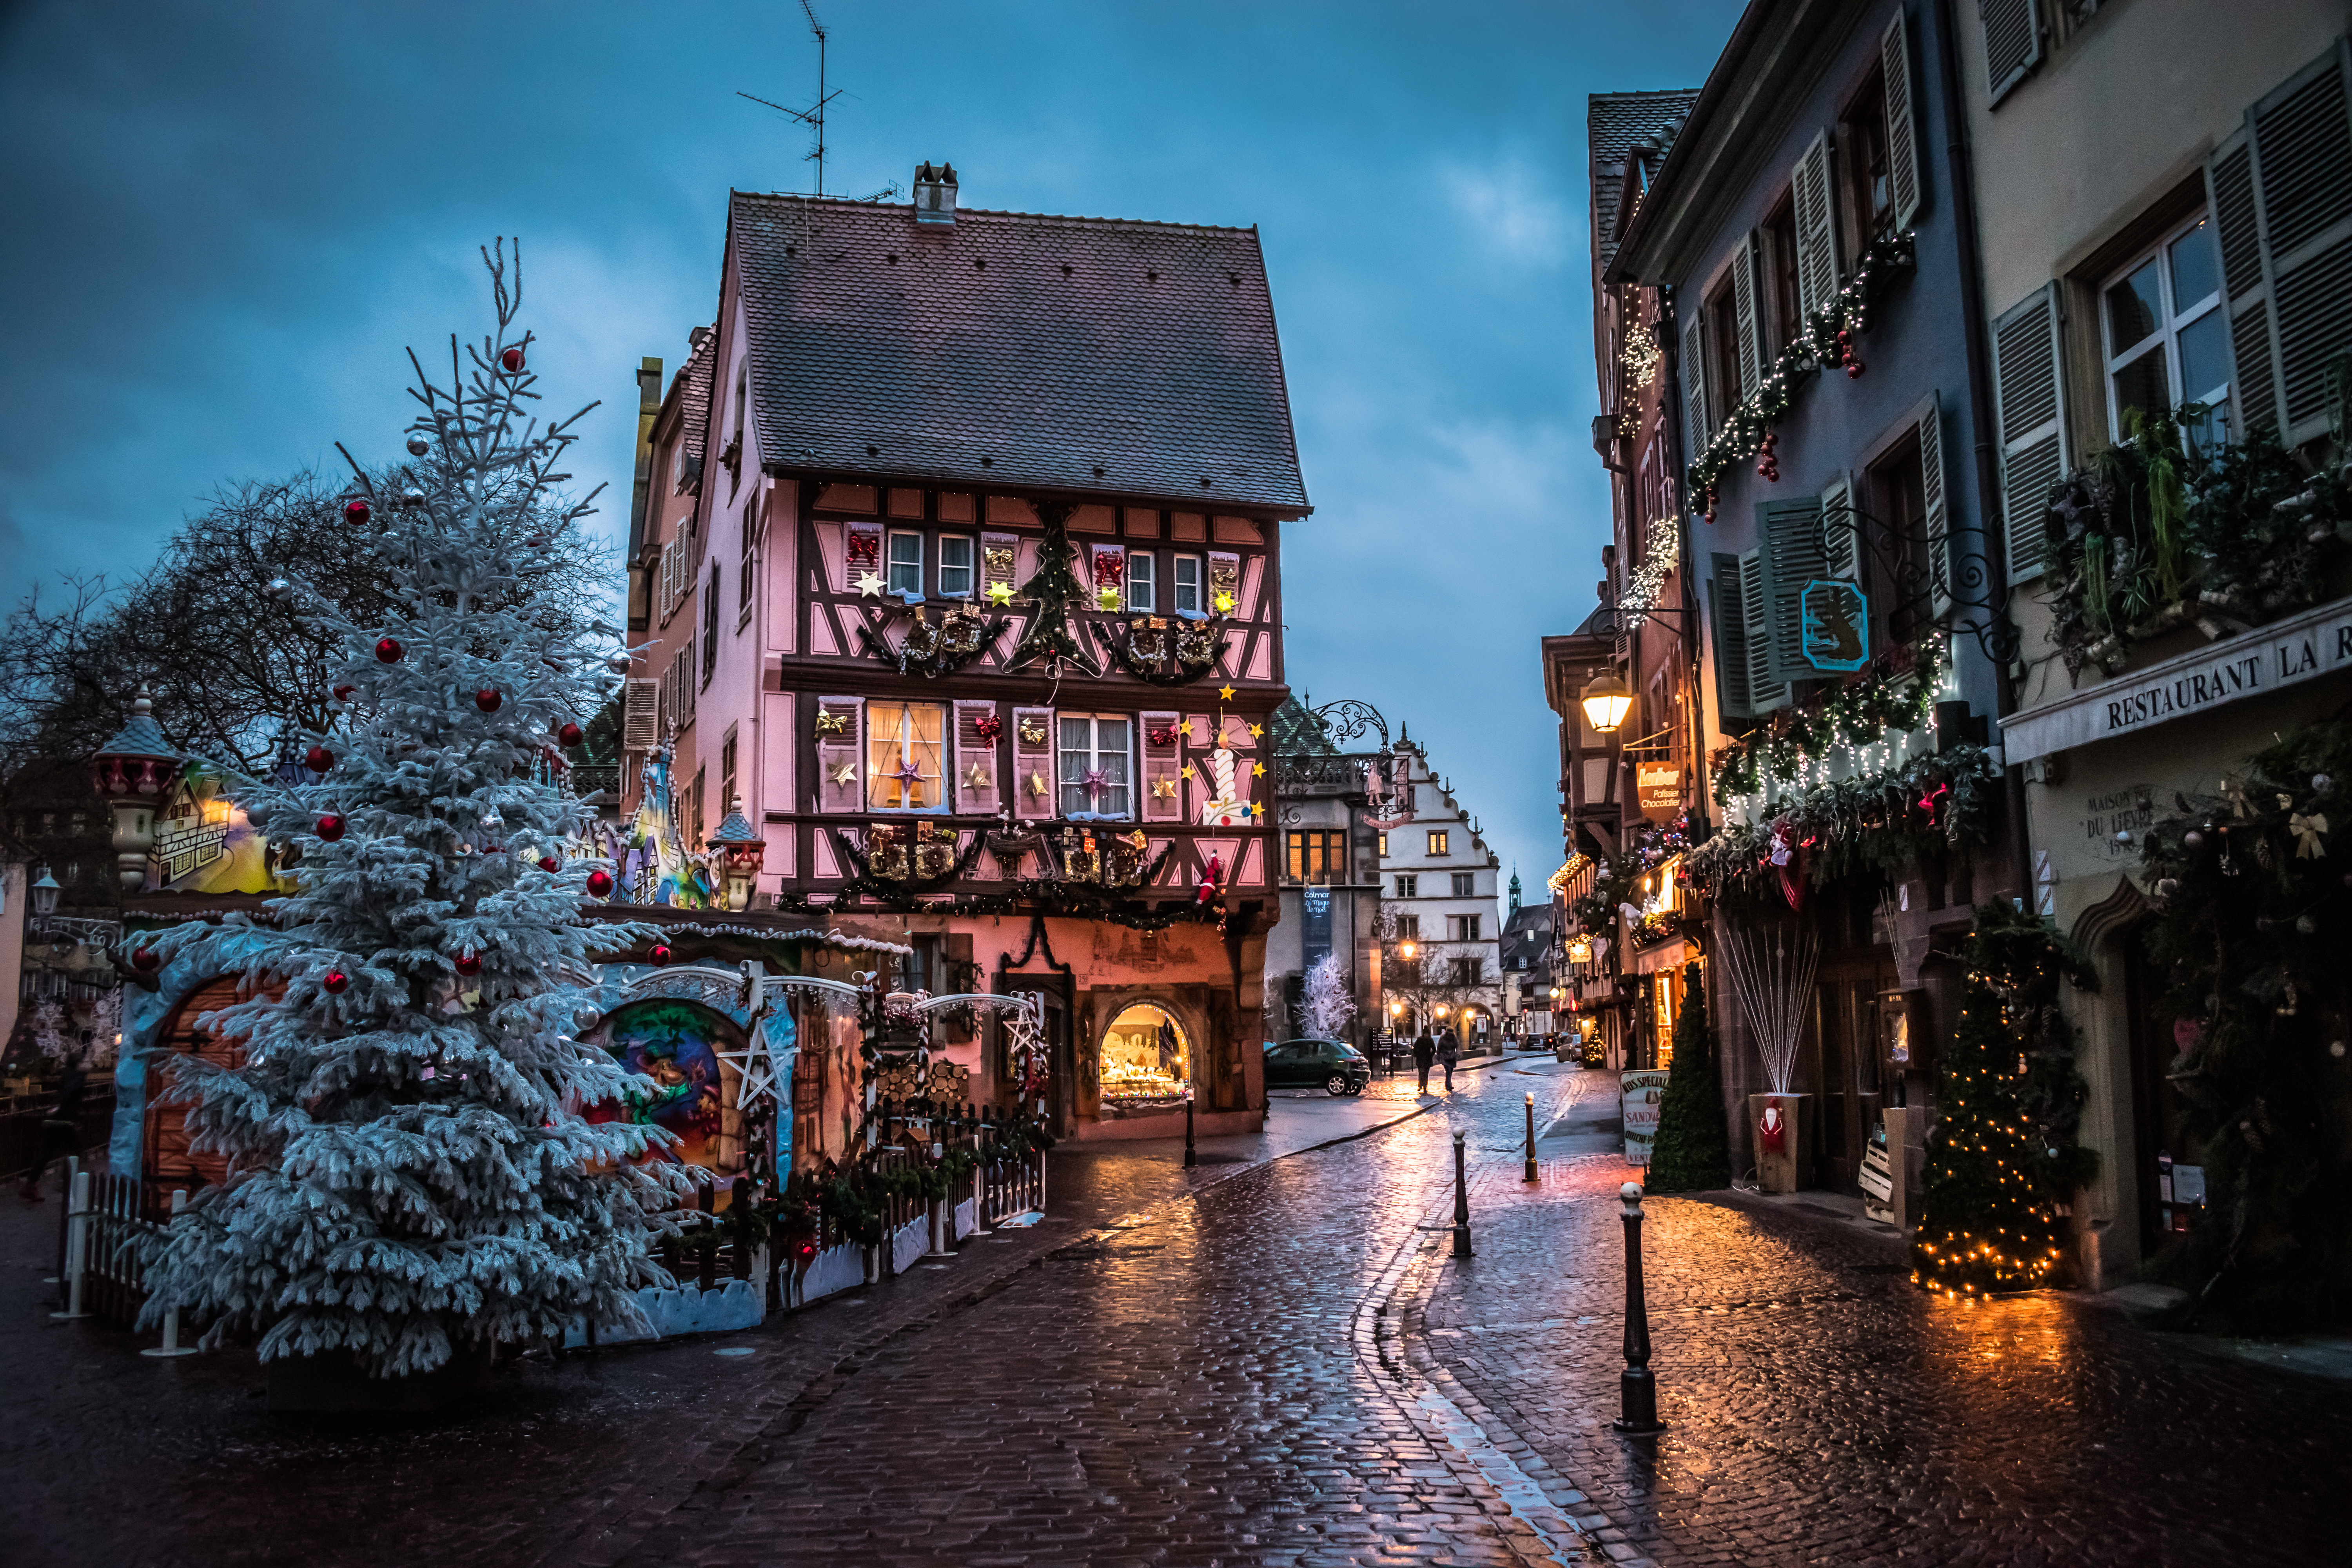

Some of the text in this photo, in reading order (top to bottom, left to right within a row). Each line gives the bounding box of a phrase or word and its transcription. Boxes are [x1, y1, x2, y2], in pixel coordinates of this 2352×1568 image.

[2108, 655, 2260, 730] RESTAURANT
[2280, 640, 2318, 678] LA
[1639, 768, 1679, 787] Lorber
[1641, 798, 1680, 808] Chocolatier
[2088, 791, 2130, 813] MAISON
[2087, 817, 2103, 838] DU
[1622, 1079, 1638, 1094] NOS
